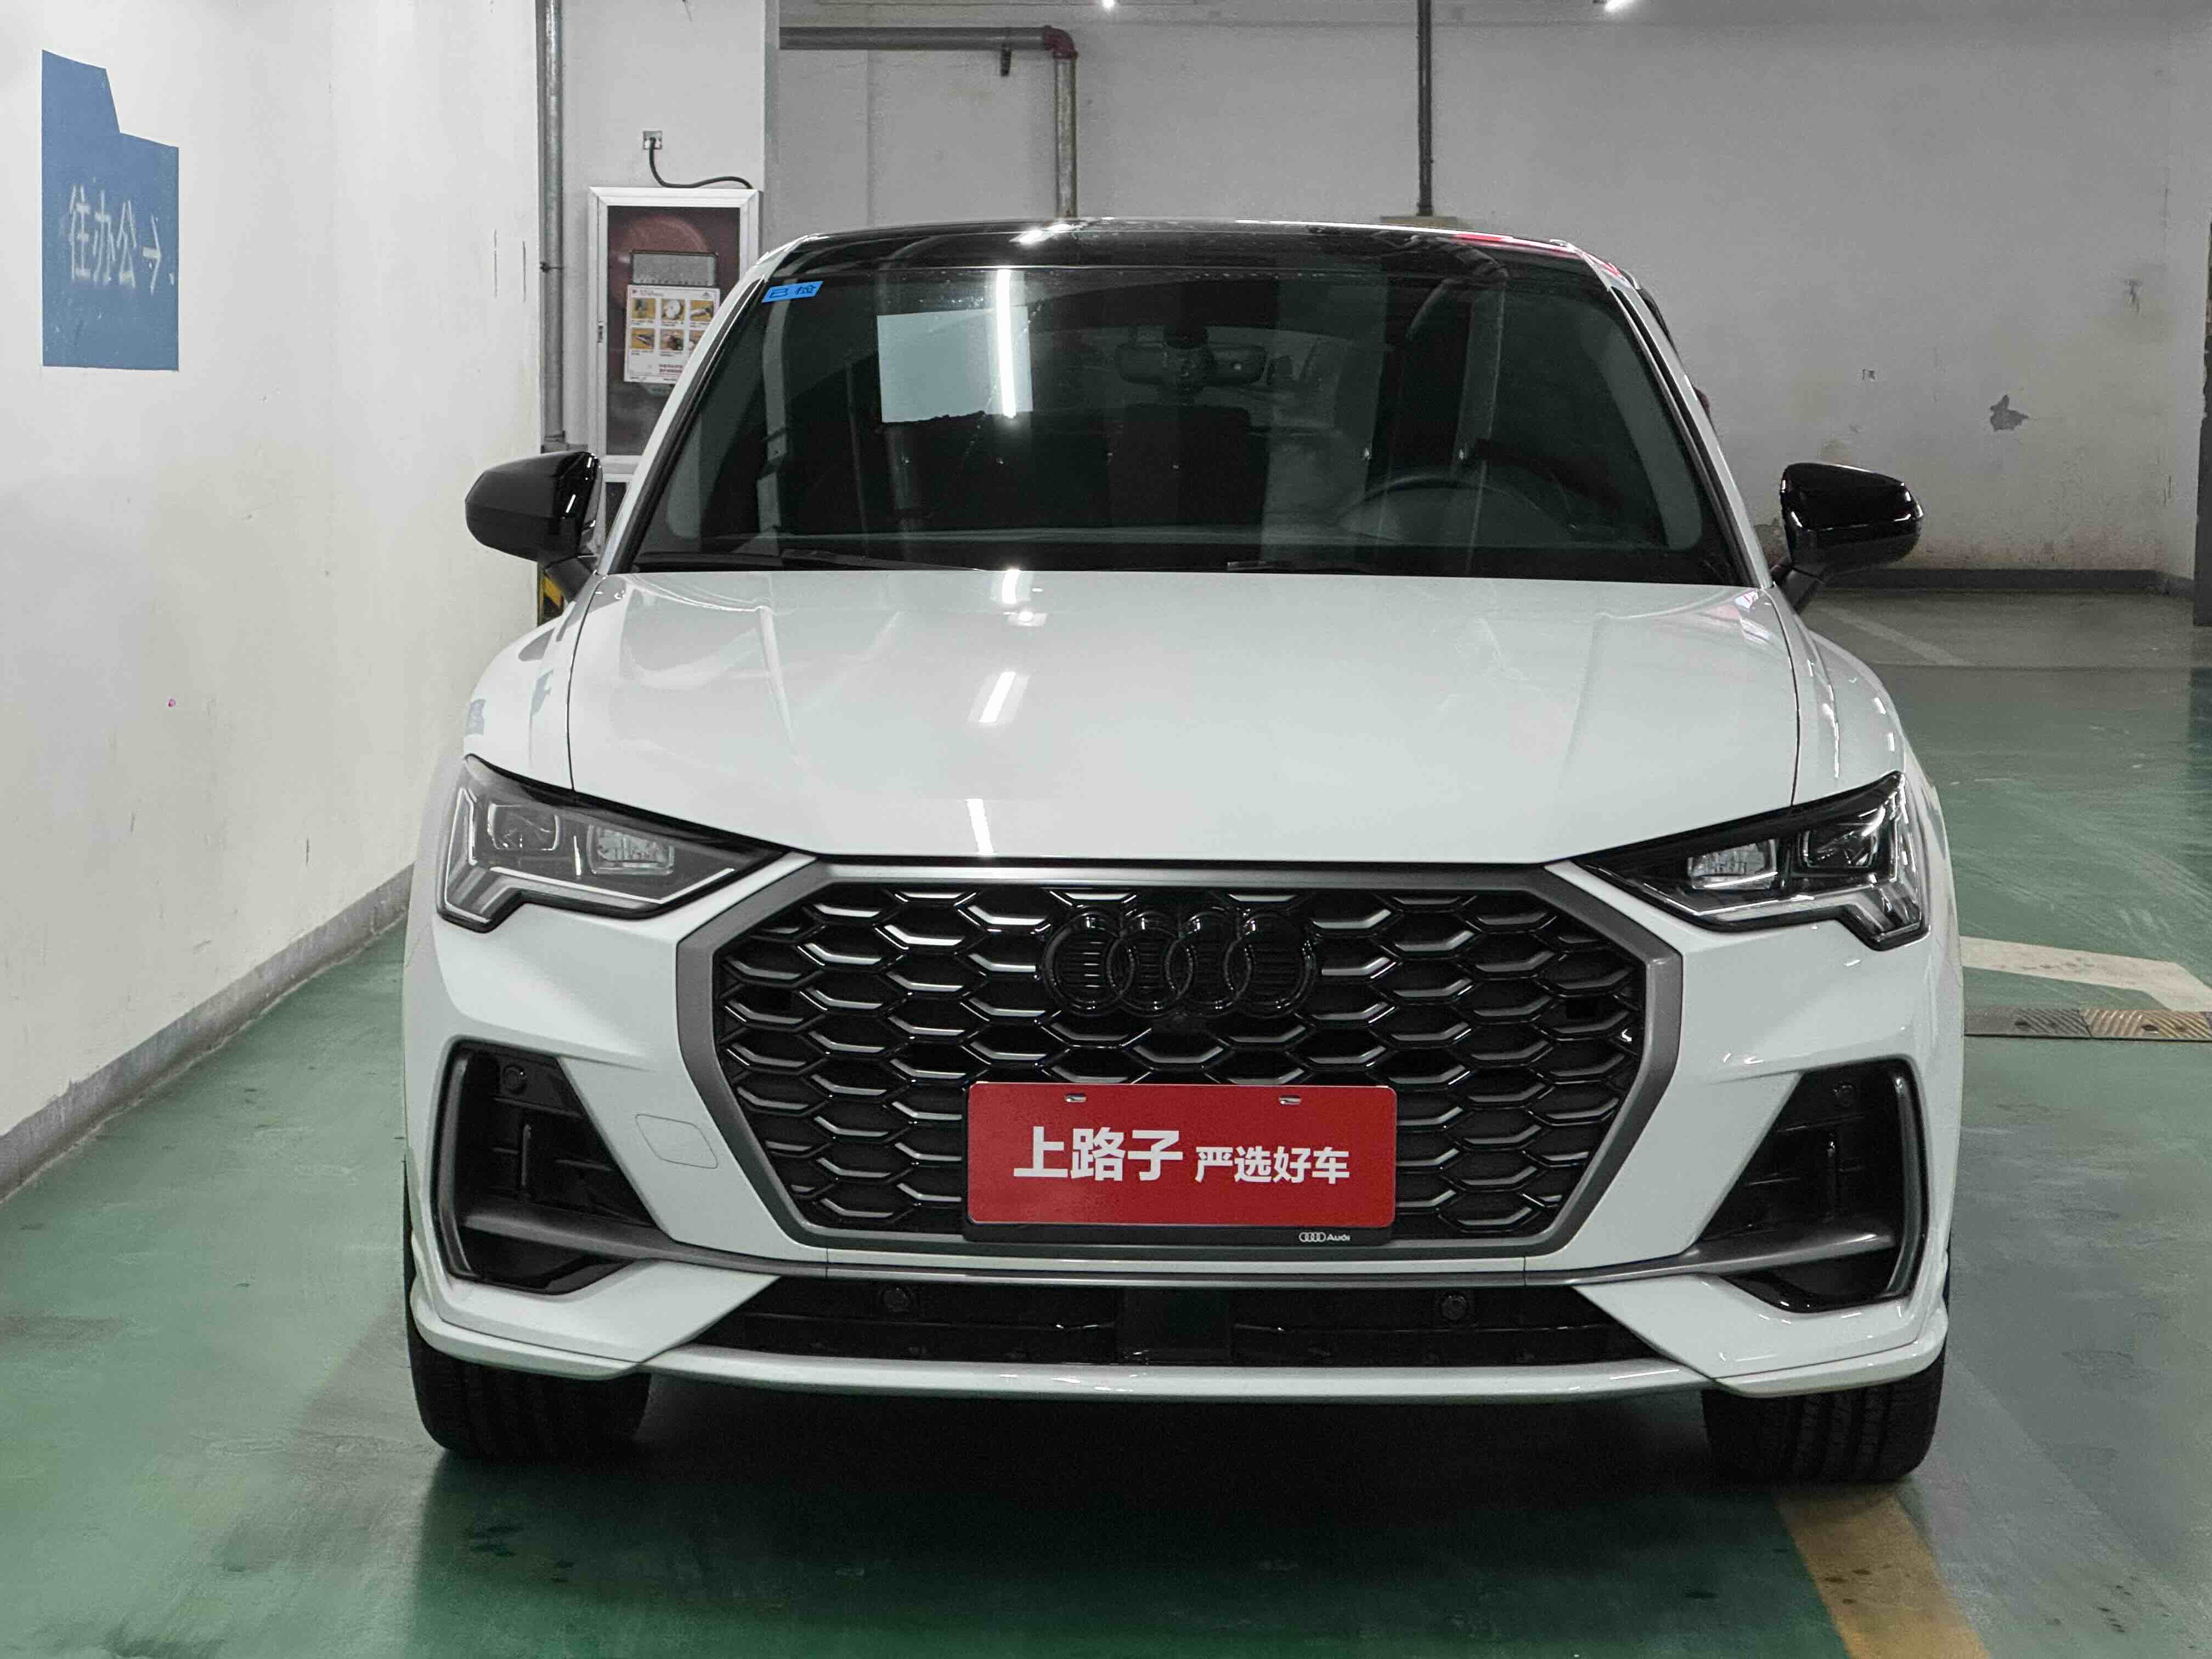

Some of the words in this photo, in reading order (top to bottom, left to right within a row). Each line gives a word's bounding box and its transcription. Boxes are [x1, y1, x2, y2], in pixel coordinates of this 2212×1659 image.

[1013, 1126, 1183, 1182] 上路子
[1194, 1146, 1350, 1184] 严选好车
[1326, 1233, 1351, 1242] Audi
